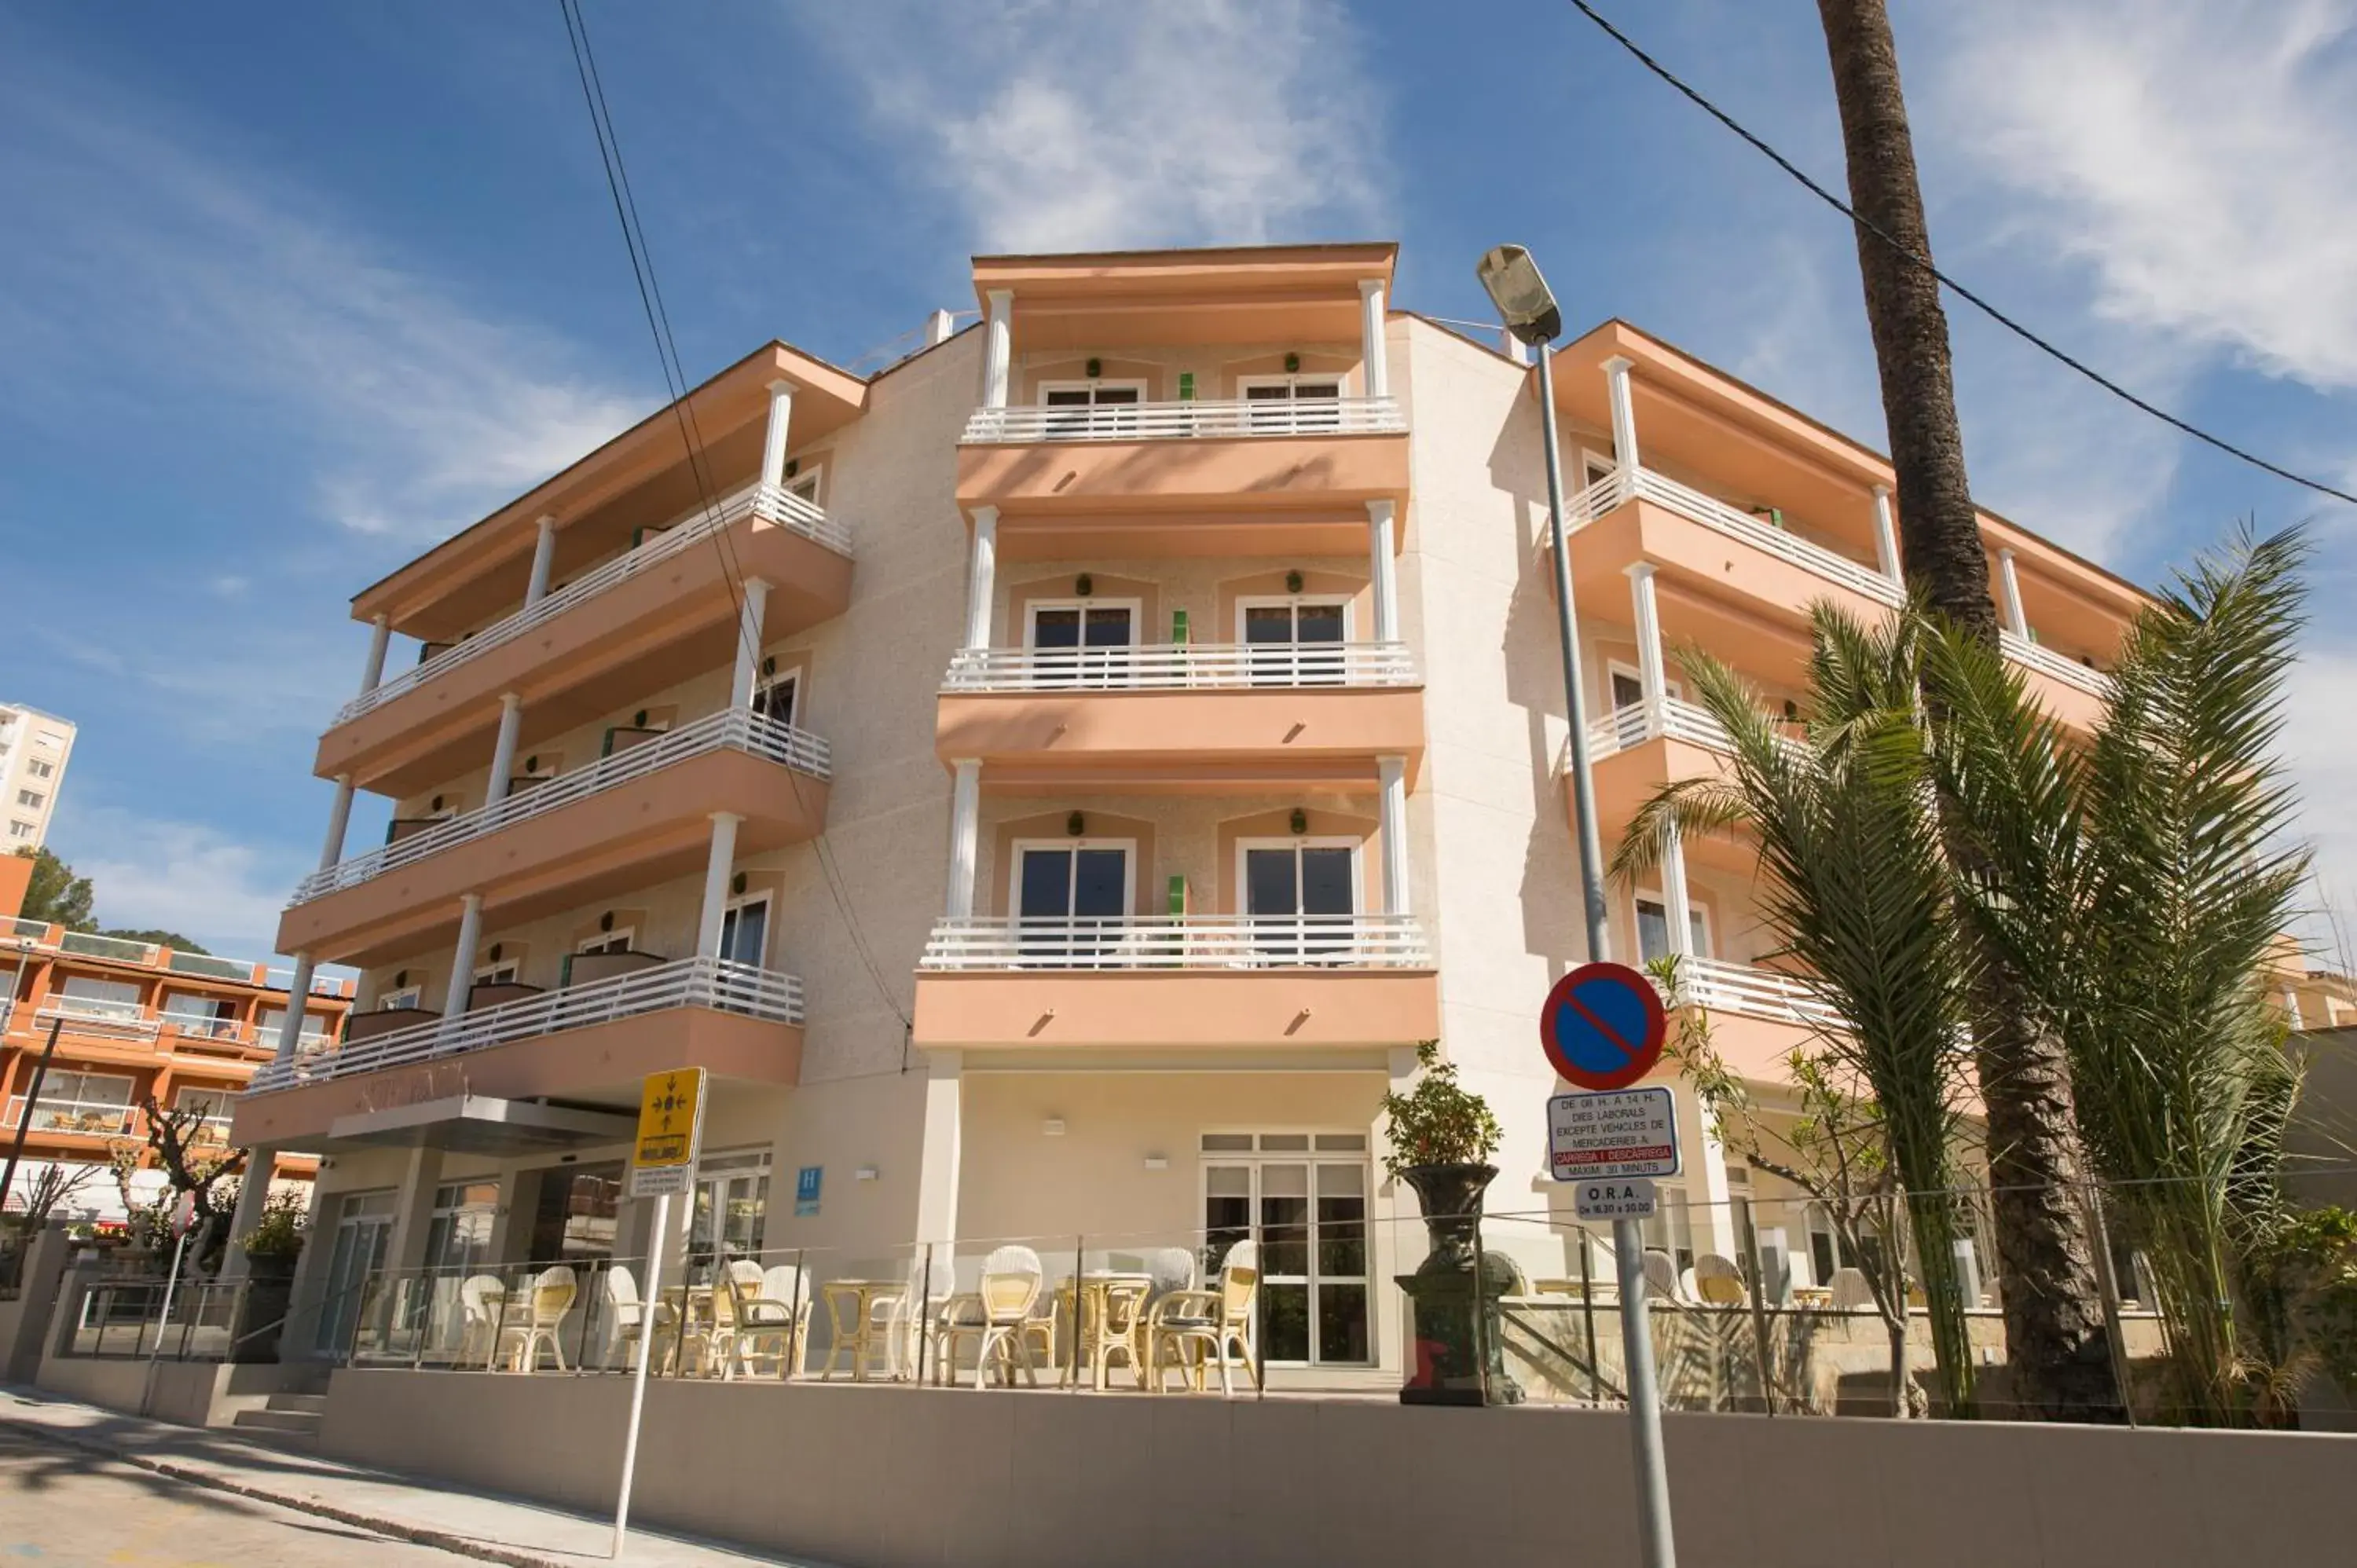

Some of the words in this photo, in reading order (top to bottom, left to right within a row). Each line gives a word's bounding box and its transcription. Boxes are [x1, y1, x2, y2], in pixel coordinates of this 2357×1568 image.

[1561, 1100, 1575, 1110] DE
[1614, 1097, 1622, 1105] A
[1628, 1095, 1638, 1104] 14
[1571, 1112, 1593, 1122] DIES
[1597, 1107, 1646, 1120] LABORALS
[1556, 1125, 1597, 1136] EXCEPTE
[1600, 1122, 1647, 1133] VEHICLES
[1651, 1119, 1664, 1130] DE
[1572, 1136, 1637, 1148] MERCADERIES
[1621, 1162, 1659, 1174] MINUTS
[804, 1170, 816, 1189] H
[1588, 1185, 1640, 1200] O.R.A.
